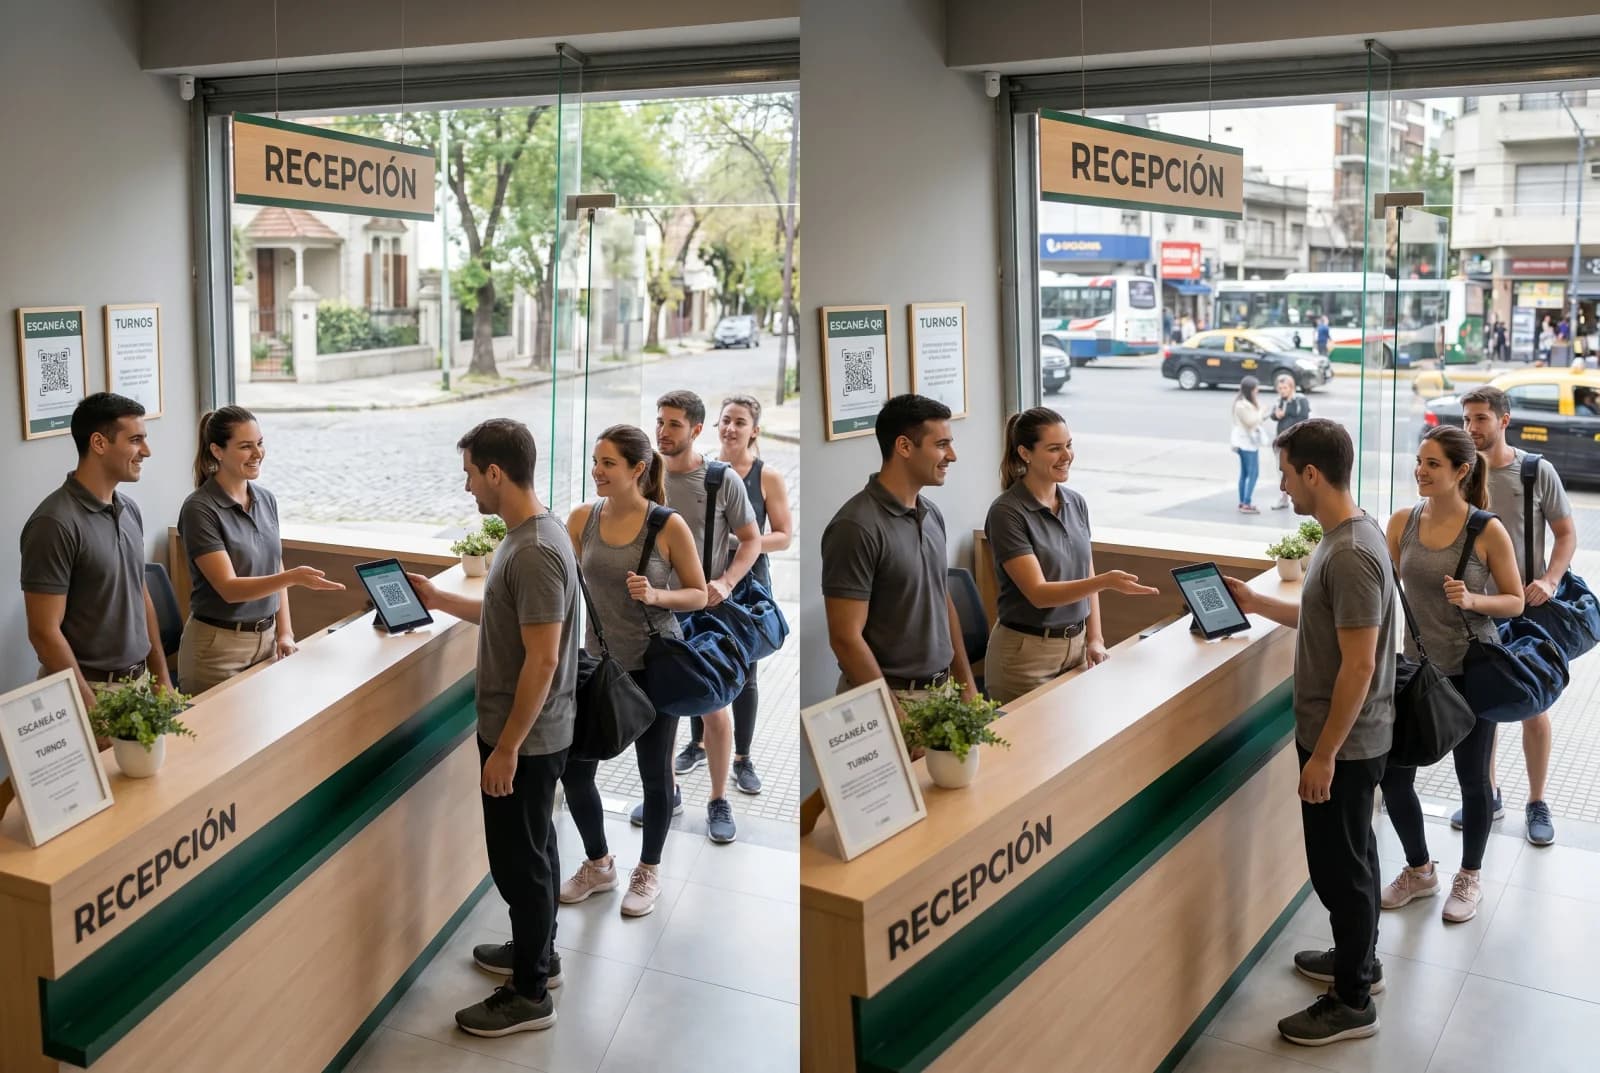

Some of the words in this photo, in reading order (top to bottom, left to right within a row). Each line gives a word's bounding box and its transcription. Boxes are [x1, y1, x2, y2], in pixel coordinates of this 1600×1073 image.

[265, 145, 416, 199] RECEPCIÓN
[1072, 142, 1223, 198] RECEPCIÓN
[26, 318, 65, 332] ESCANEÁ
[66, 320, 78, 331] QR
[115, 317, 153, 329] TURNOS
[830, 317, 869, 331] ESCANEÁ
[870, 319, 883, 330] QR
[919, 316, 958, 329] TURNOS
[35, 738, 67, 758] TURNOS
[847, 750, 879, 770] TURNOS
[74, 803, 236, 944] RECEPCIÓN
[888, 814, 1052, 961] RECEPCIÓN
